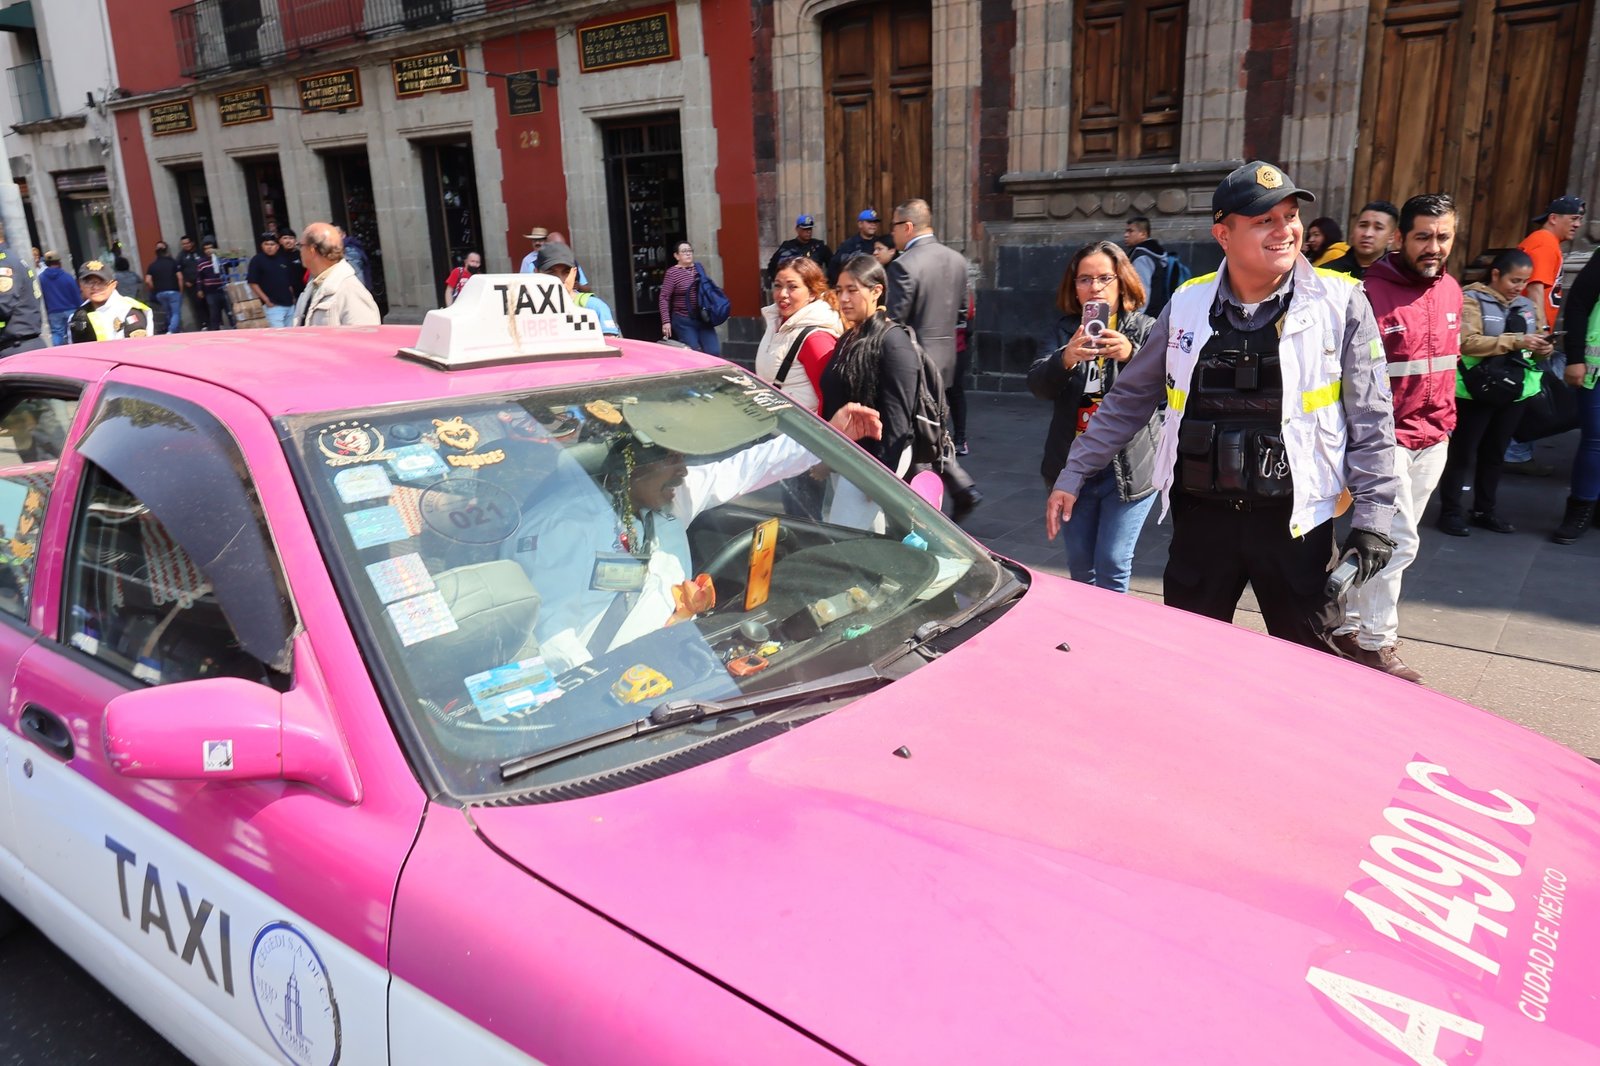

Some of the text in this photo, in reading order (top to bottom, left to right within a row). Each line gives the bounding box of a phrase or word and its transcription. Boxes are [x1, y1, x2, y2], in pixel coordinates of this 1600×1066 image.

[494, 283, 566, 316] TAXI
[514, 317, 560, 337] IBRE
[105, 834, 235, 998] TAXI
[1305, 761, 1536, 1066] A 1490 C
[1518, 867, 1568, 1022] CIUDAD DE MÉXICO
